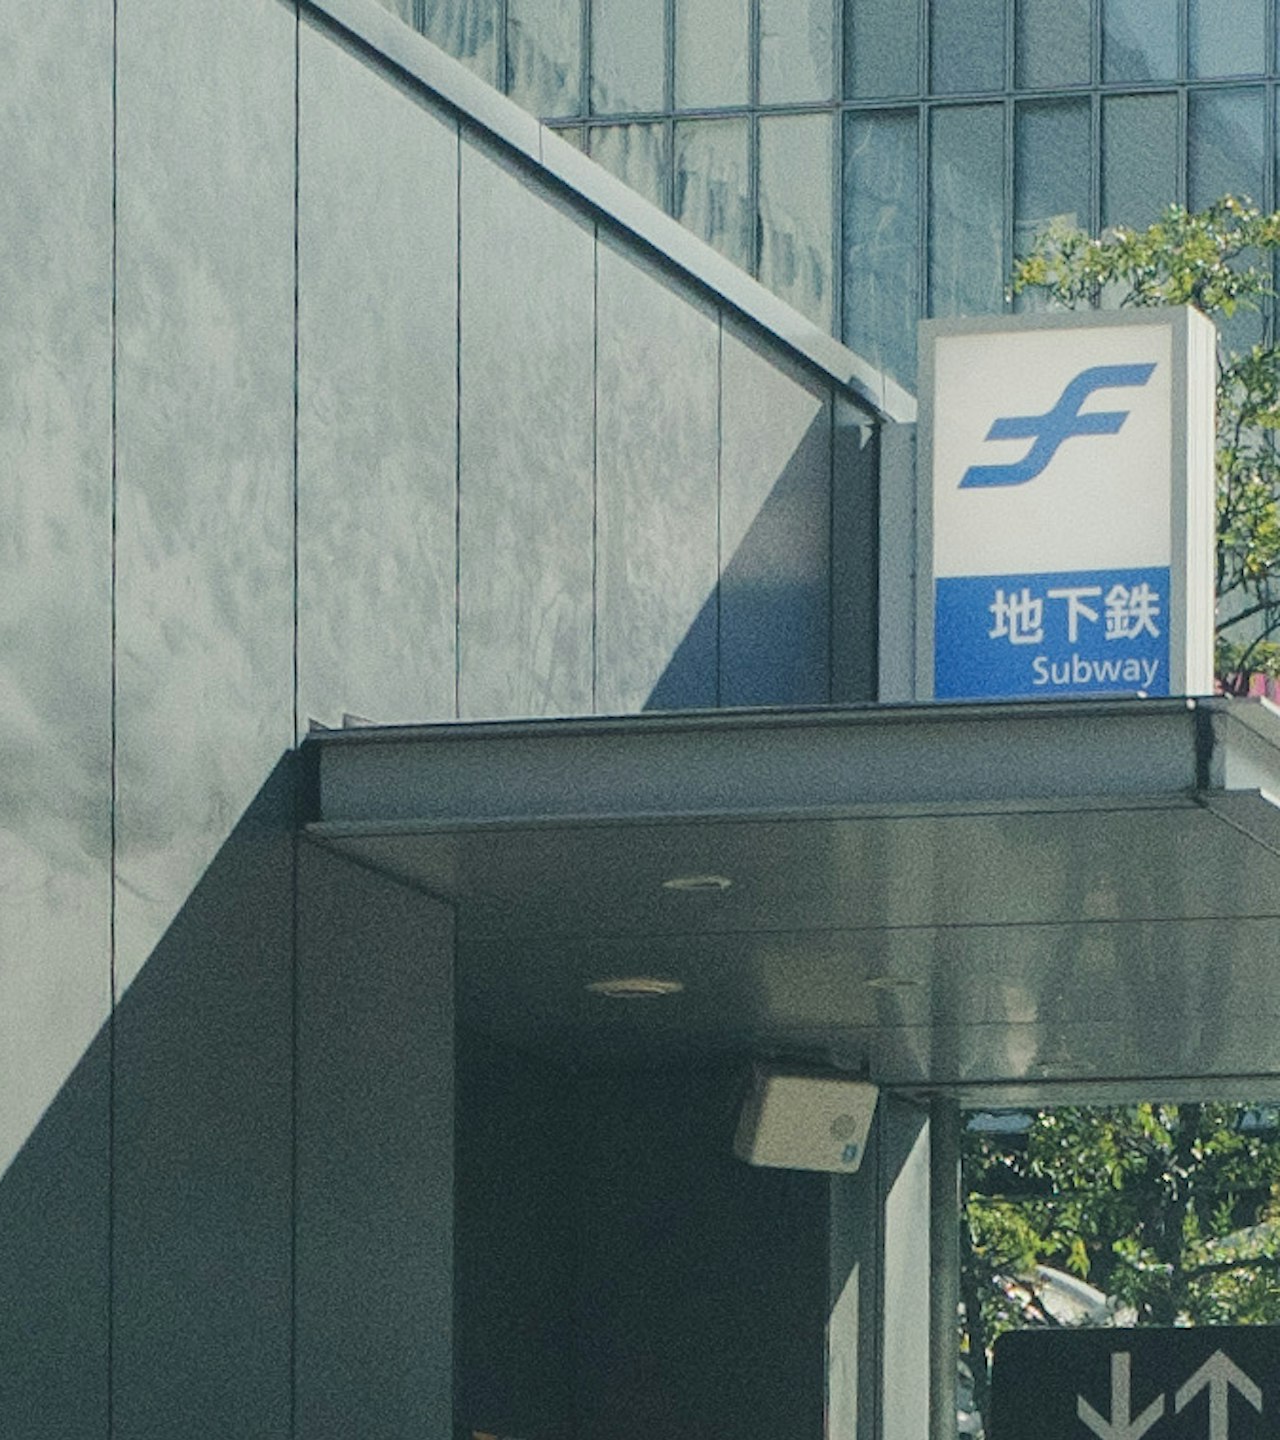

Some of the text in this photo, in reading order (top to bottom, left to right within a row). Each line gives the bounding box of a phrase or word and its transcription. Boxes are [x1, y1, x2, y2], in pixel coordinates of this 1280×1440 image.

[989, 582, 1161, 645] 地下鉄
[1032, 653, 1159, 689] Subway
